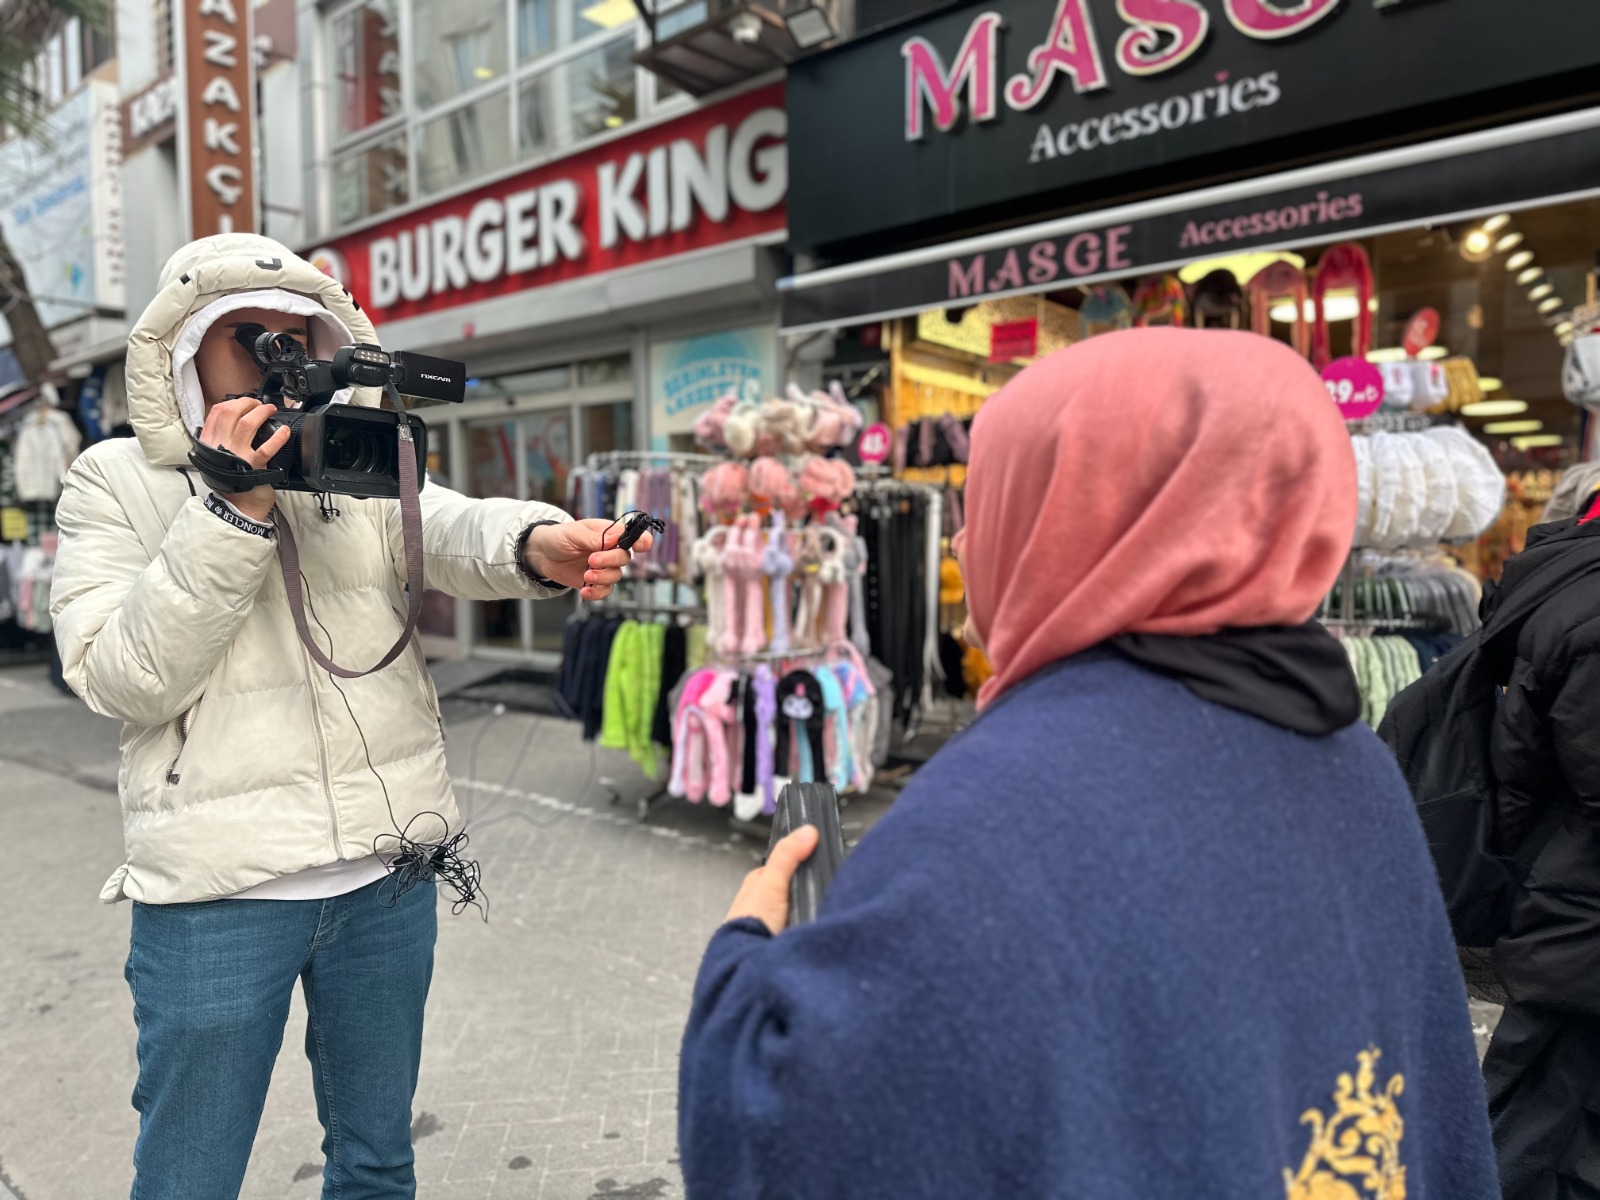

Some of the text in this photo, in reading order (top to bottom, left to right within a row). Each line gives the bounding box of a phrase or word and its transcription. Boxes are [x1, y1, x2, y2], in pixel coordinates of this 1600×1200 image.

[902, 0, 1402, 141] MAS
[1029, 71, 1280, 163] Accessories
[369, 107, 788, 310] BURGER KING
[947, 192, 1363, 298] MASGE Accessories
[223, 510, 265, 536] MONCLER
